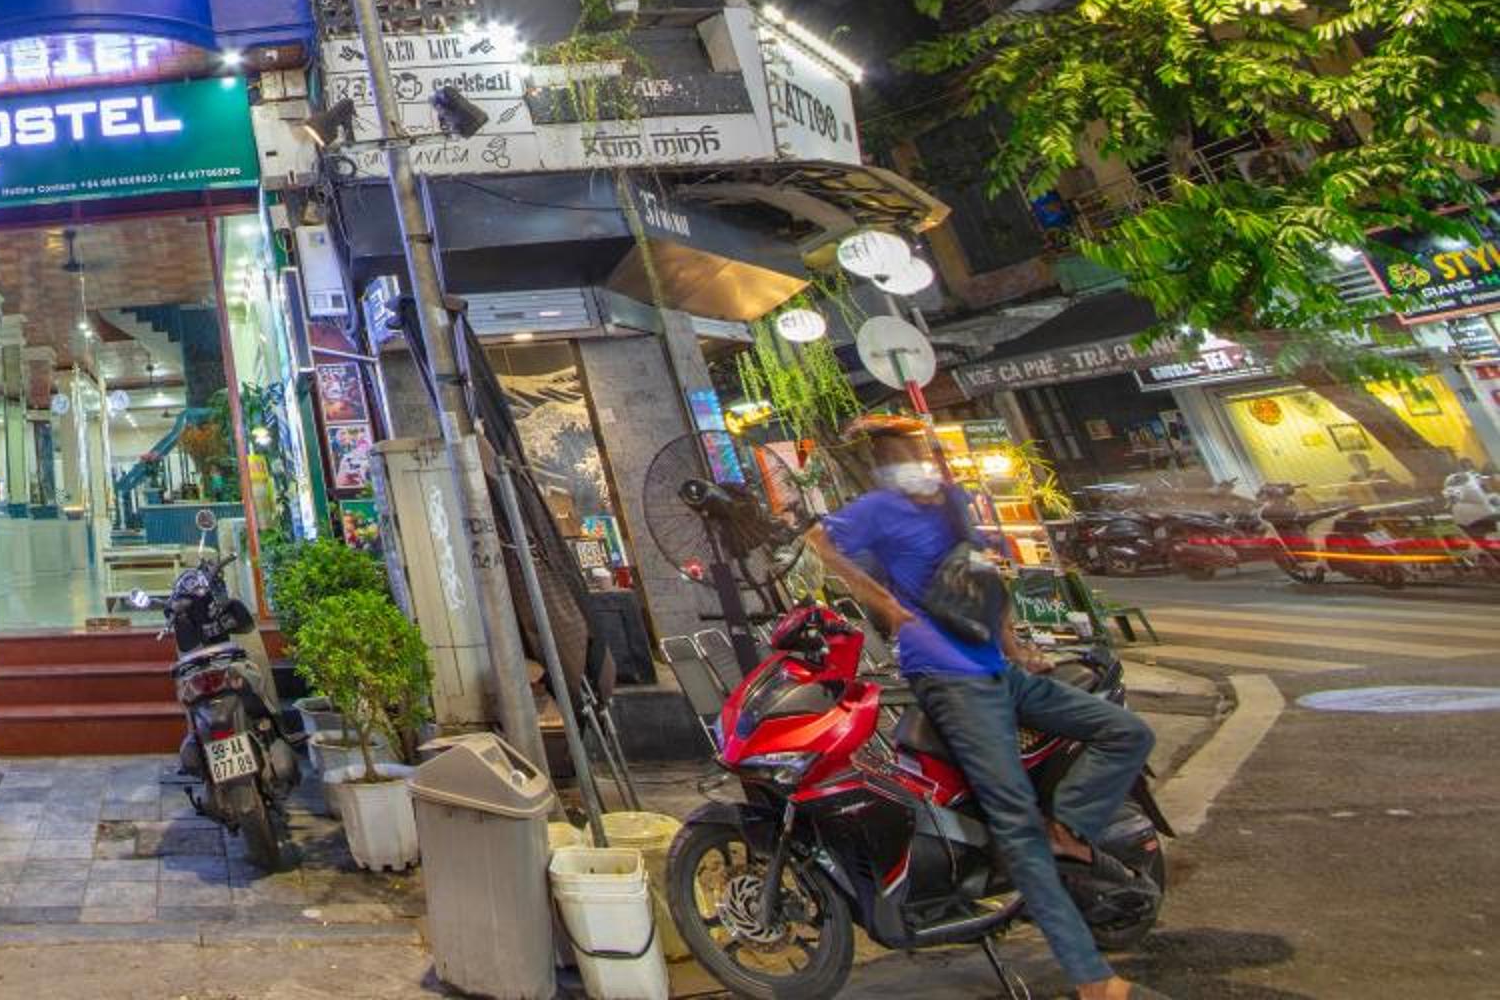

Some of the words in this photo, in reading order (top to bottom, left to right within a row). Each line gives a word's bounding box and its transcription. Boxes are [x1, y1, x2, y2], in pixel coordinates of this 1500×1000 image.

[427, 38, 463, 61] LIFE
[432, 70, 512, 93] cocktail
[770, 70, 838, 142] TATTOO
